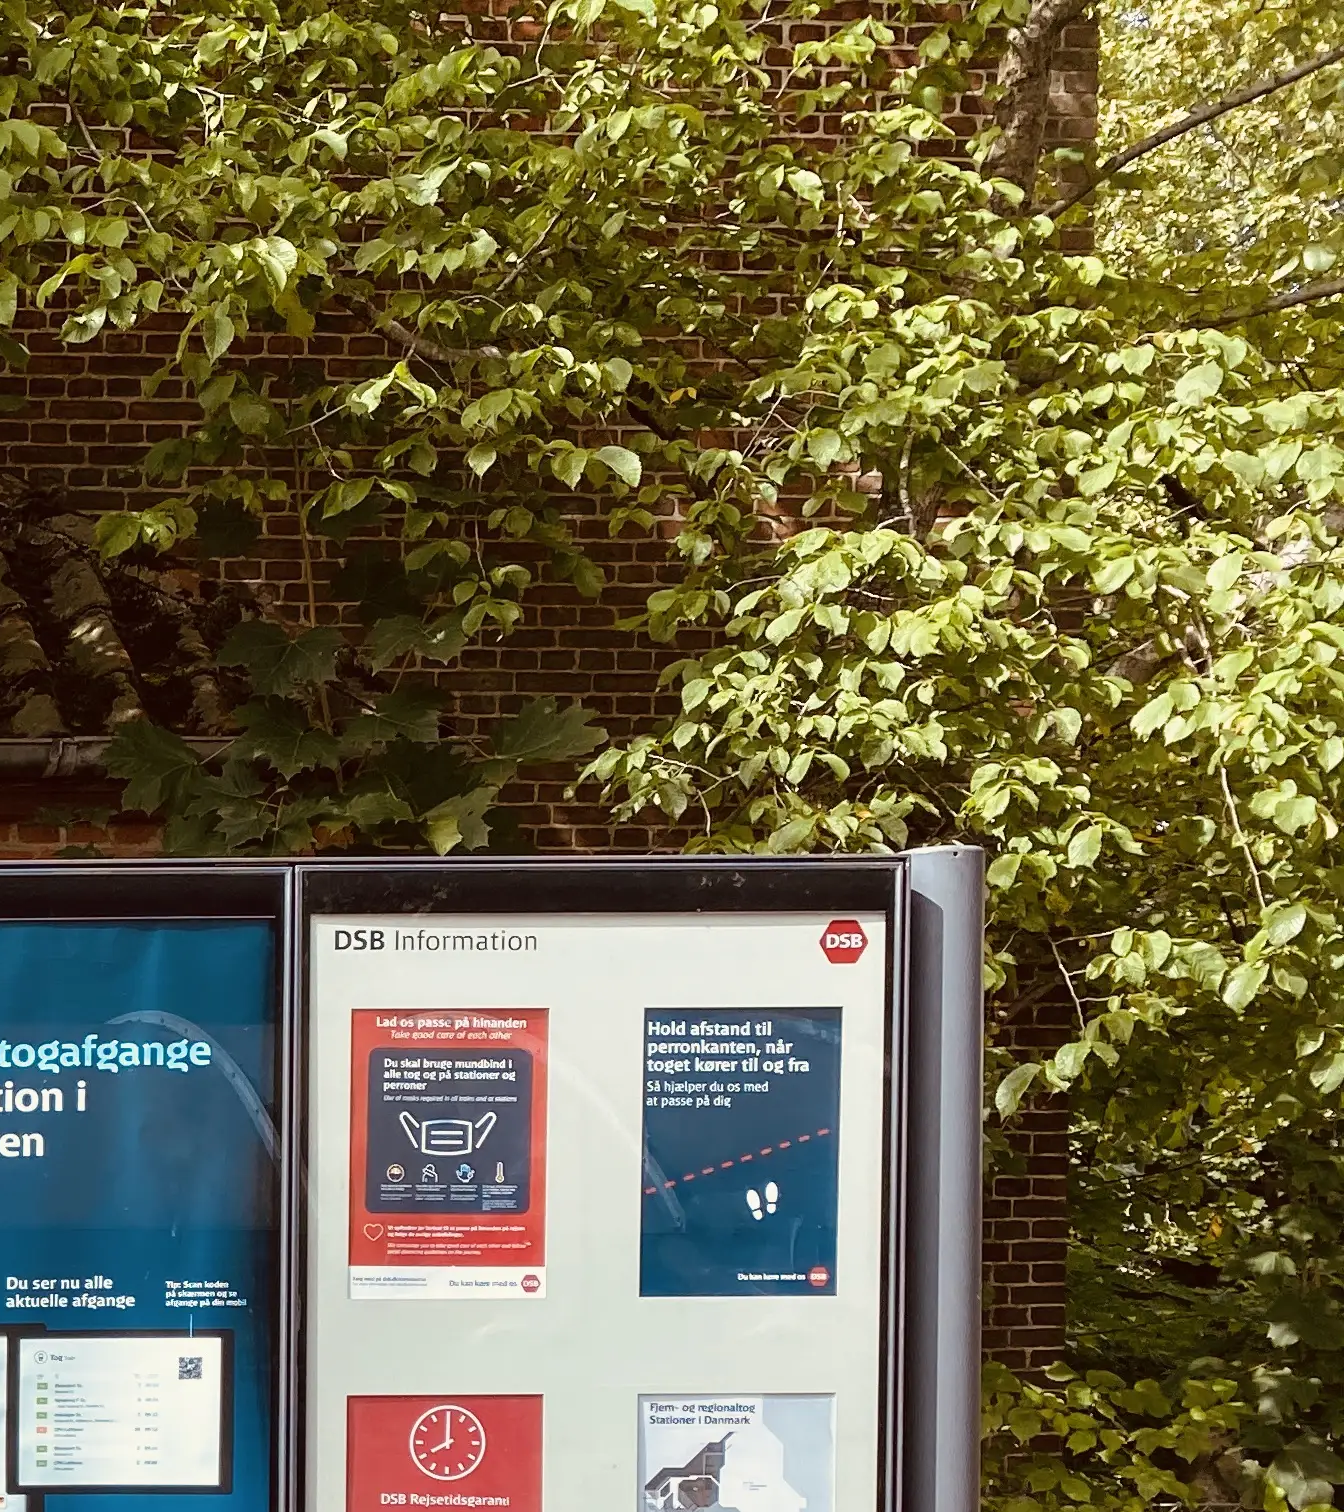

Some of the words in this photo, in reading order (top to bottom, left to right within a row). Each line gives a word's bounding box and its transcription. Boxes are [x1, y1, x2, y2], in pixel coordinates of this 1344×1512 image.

[335, 930, 384, 950] DSB
[396, 930, 536, 950] Information
[825, 932, 864, 950] DSB
[377, 1017, 397, 1027] Lad
[399, 1019, 414, 1027] os
[418, 1019, 451, 1029] passe
[455, 1017, 469, 1029] på
[472, 1017, 526, 1028] hinanden
[648, 1021, 685, 1035] Hold
[690, 1021, 750, 1035] afstand
[755, 1022, 771, 1036] til
[391, 1030, 410, 1039] Take
[412, 1031, 434, 1040] good
[457, 1031, 466, 1039] of
[468, 1031, 487, 1039] each
[489, 1031, 512, 1039] other
[648, 1039, 761, 1056] perronkanten,
[766, 1039, 793, 1054] når
[384, 1058, 398, 1067] Du
[401, 1059, 420, 1068] skal
[423, 1058, 452, 1069] bruge
[455, 1059, 505, 1068] mundbind
[509, 1060, 512, 1068] i
[647, 1060, 690, 1074] toget
[695, 1057, 738, 1071] kører
[742, 1058, 758, 1072] til
[763, 1060, 783, 1074] og
[788, 1058, 809, 1072] fra
[384, 1069, 401, 1078] alle
[404, 1071, 420, 1080] tog
[423, 1071, 436, 1080] og
[439, 1070, 451, 1081] på
[454, 1071, 500, 1079] stationer
[502, 1072, 515, 1081] og
[384, 1082, 427, 1091] perroner
[647, 1081, 660, 1092] Så
[664, 1081, 707, 1094] hjælper
[709, 1081, 723, 1092] du
[727, 1083, 740, 1092] os
[744, 1081, 768, 1092] med
[77, 1081, 87, 1111] i
[646, 1097, 657, 1106] at
[661, 1097, 693, 1108] passe
[696, 1095, 710, 1108] på
[713, 1095, 731, 1107] dig
[7, 1277, 28, 1289] Du
[33, 1280, 57, 1289] ser
[61, 1279, 79, 1289] nu
[85, 1276, 113, 1289] alle
[166, 1289, 176, 1298] på
[6, 1294, 68, 1307] aktuelle
[72, 1293, 135, 1309] afgange
[166, 1299, 198, 1307] afgange
[200, 1299, 210, 1307] på
[650, 1403, 678, 1413] Fjern-
[682, 1405, 695, 1413] og
[698, 1403, 755, 1413] regionaltog
[650, 1415, 696, 1424] Stationer
[699, 1416, 701, 1424] i
[704, 1416, 750, 1424] Danmark
[381, 1493, 406, 1504] DSB
[410, 1494, 509, 1507] Rejsetidsgaranti
